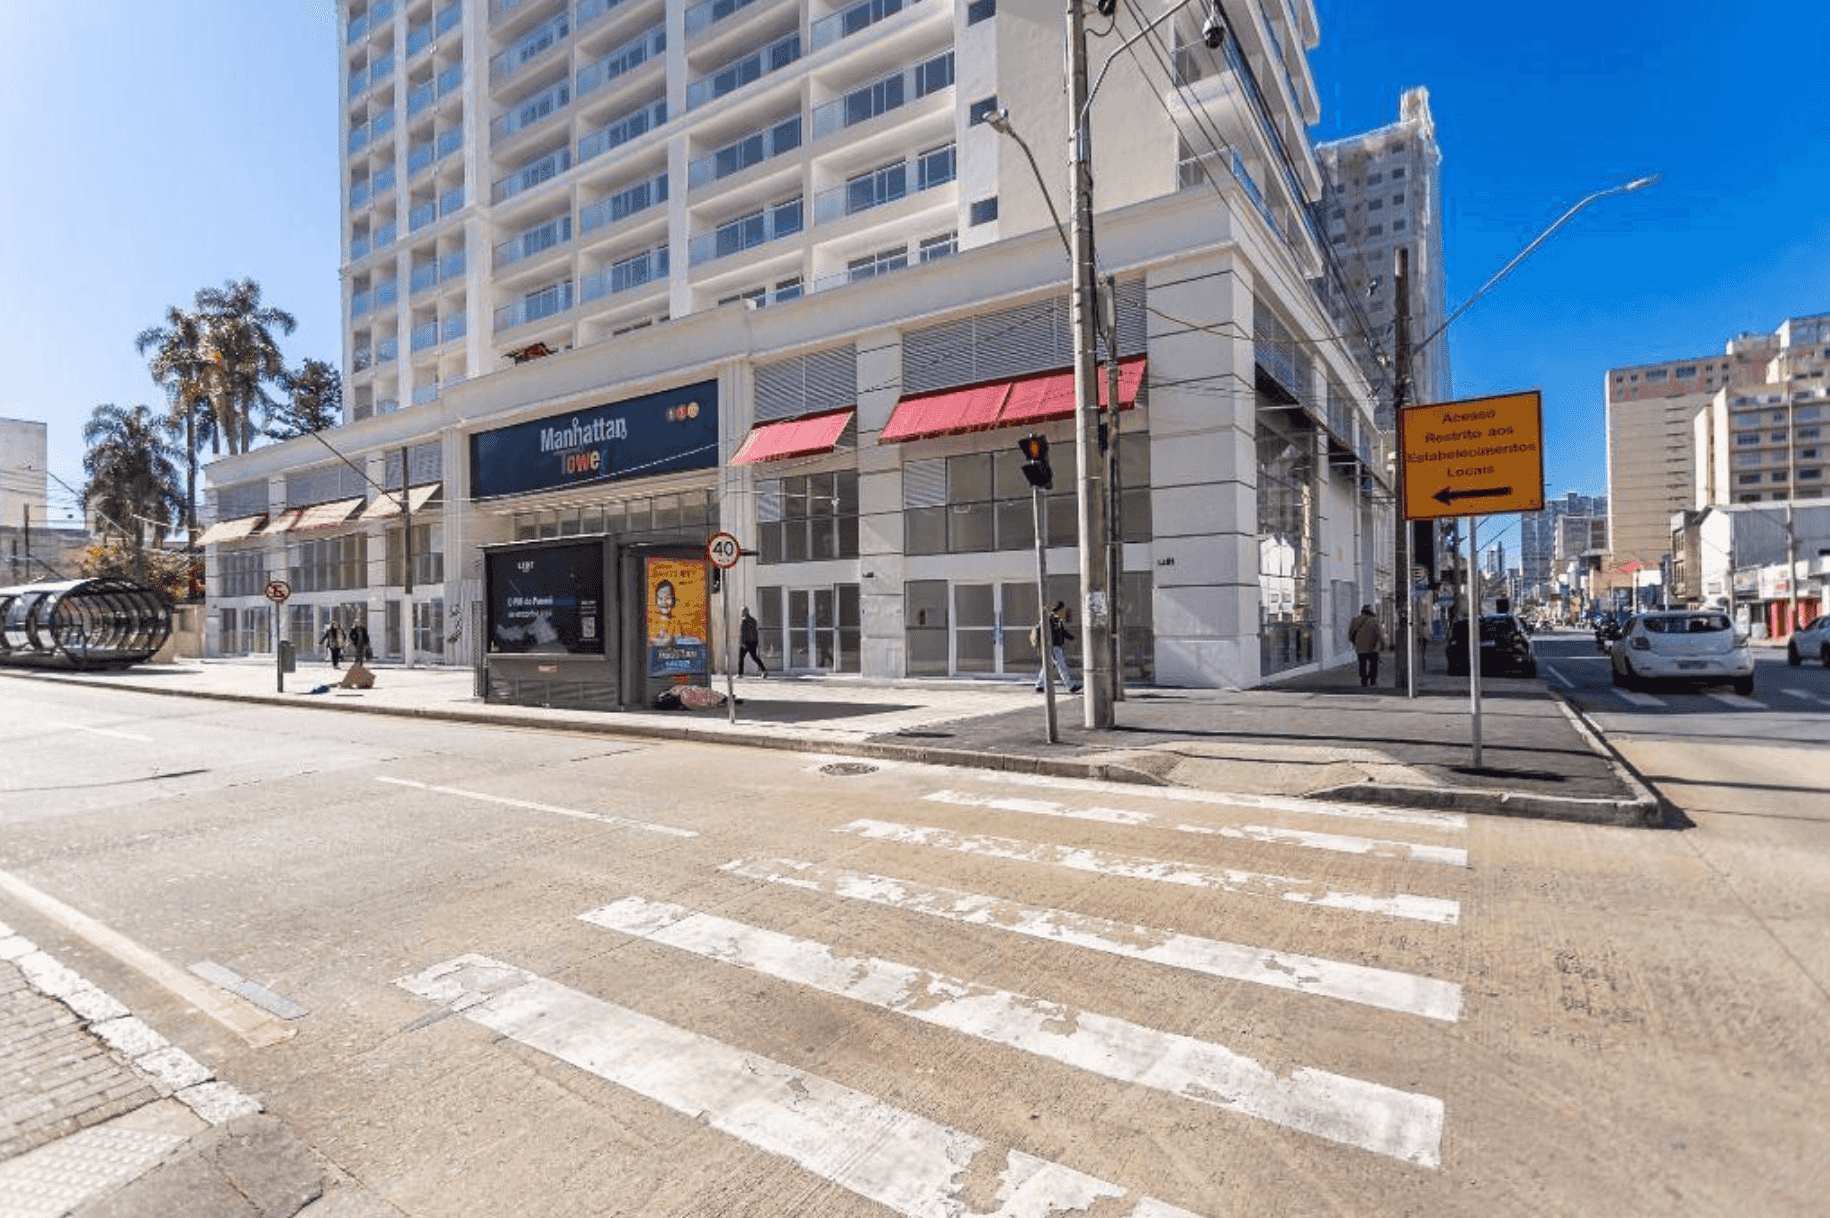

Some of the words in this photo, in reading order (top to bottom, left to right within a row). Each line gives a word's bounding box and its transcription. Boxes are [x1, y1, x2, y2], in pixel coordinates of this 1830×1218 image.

[1442, 409, 1496, 424] Acesso
[540, 416, 628, 453] Manhattan
[1425, 429, 1482, 443] Restrito
[1488, 425, 1515, 438] aos
[1447, 465, 1495, 477] Locais
[712, 541, 734, 557] 40
